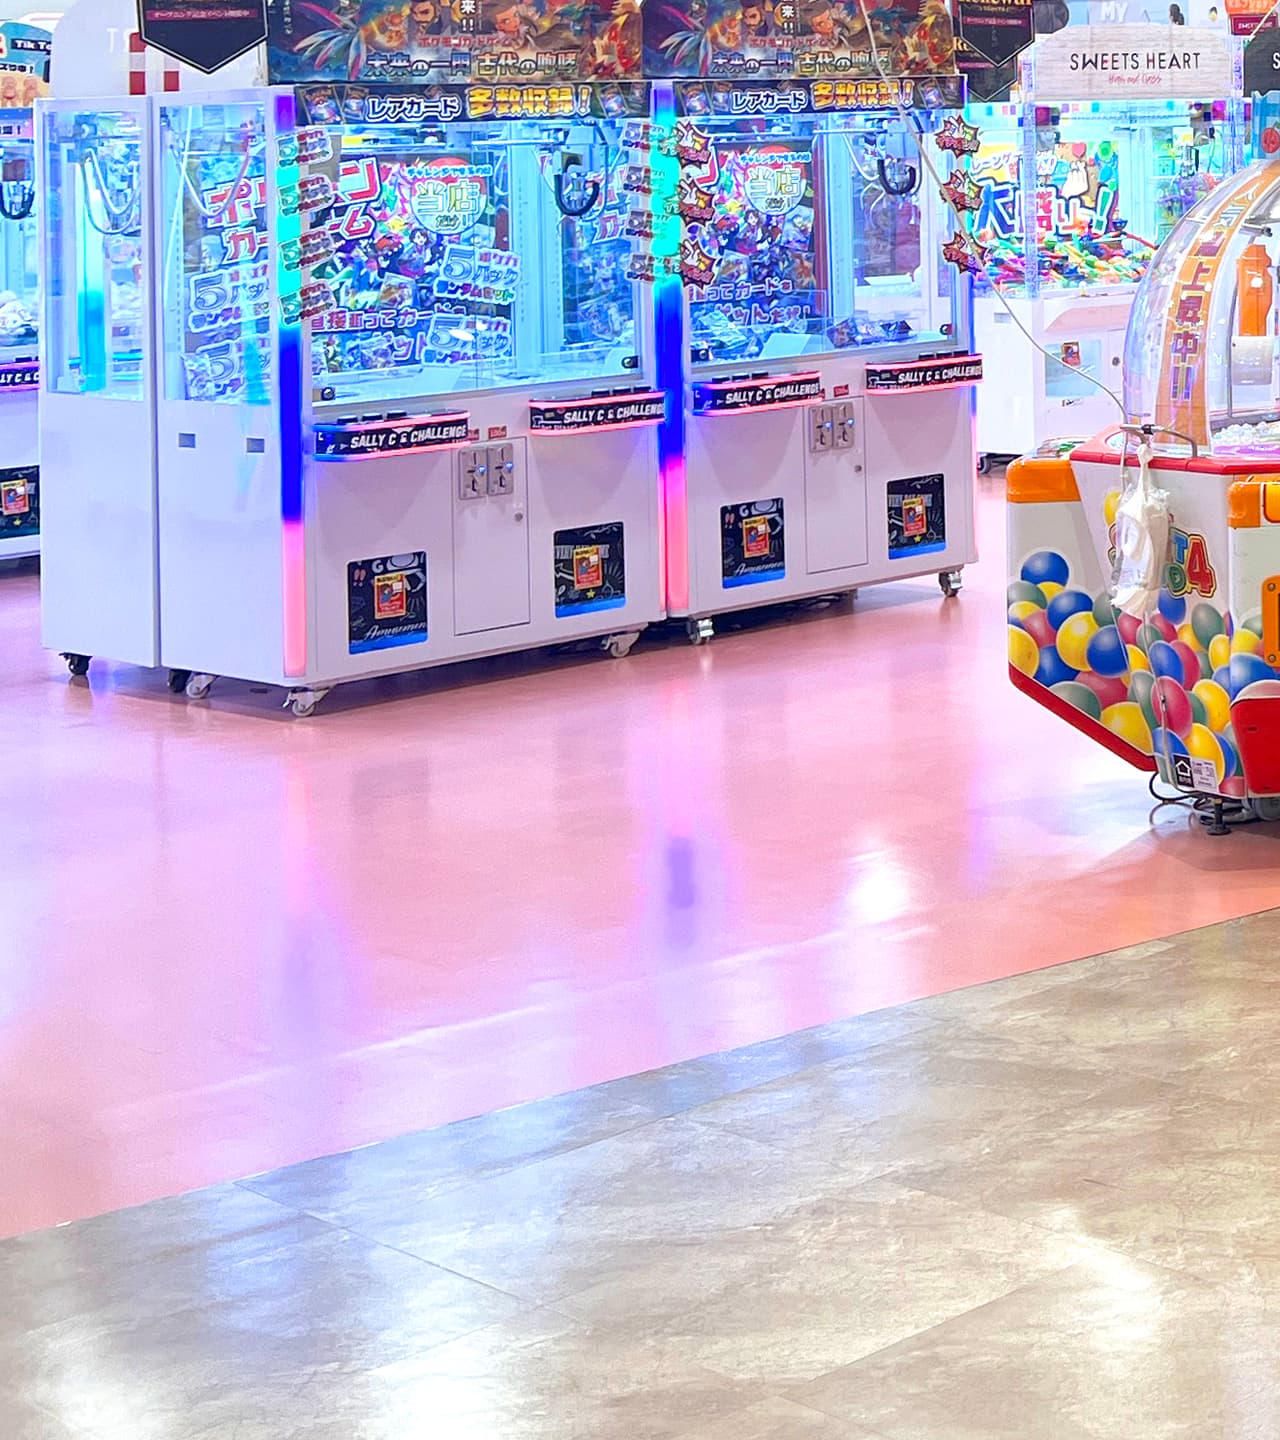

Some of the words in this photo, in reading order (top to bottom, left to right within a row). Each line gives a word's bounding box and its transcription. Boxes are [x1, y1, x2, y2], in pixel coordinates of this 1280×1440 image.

[1070, 52, 1139, 71] SWEETS
[1146, 52, 1201, 71] HEART
[367, 96, 460, 123] レアカード
[731, 90, 808, 112] レアカード
[748, 166, 801, 197] 当店
[416, 179, 480, 214] 当店
[897, 370, 927, 385] SALLY
[928, 369, 935, 383] C
[725, 389, 755, 405] SALLY
[756, 388, 764, 402] C
[773, 383, 820, 400] CHALLENGE
[563, 410, 596, 424] SALLY
[596, 409, 605, 421] C
[351, 433, 387, 449] SALLY
[388, 431, 397, 446] C
[410, 424, 467, 442] CHALLENGE
[1186, 537, 1214, 594] 4
